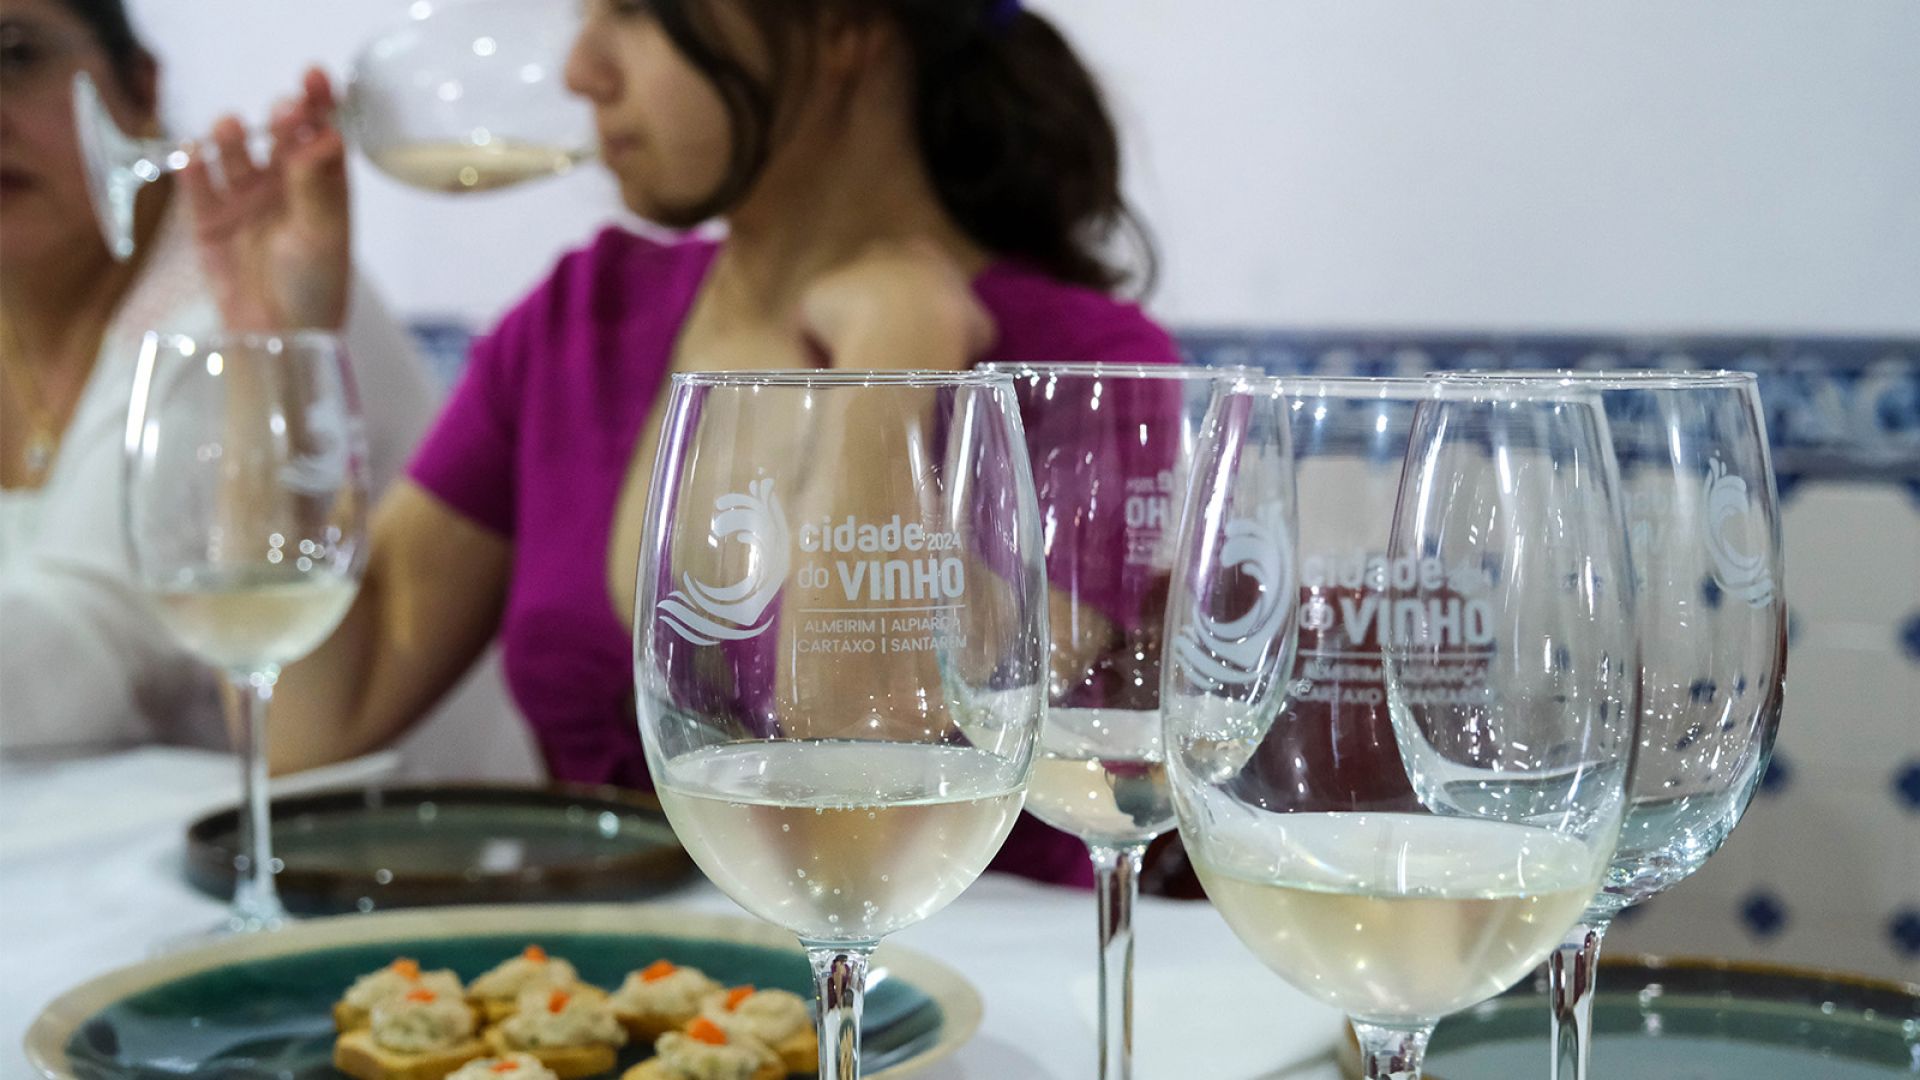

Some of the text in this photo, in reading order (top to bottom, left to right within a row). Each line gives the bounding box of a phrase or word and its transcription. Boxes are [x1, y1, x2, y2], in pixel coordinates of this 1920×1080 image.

[800, 514, 963, 552] cidade 2024
[798, 559, 830, 589] do
[804, 619, 876, 634] ALMEIRIM
[797, 638, 876, 654] CARTAXO
